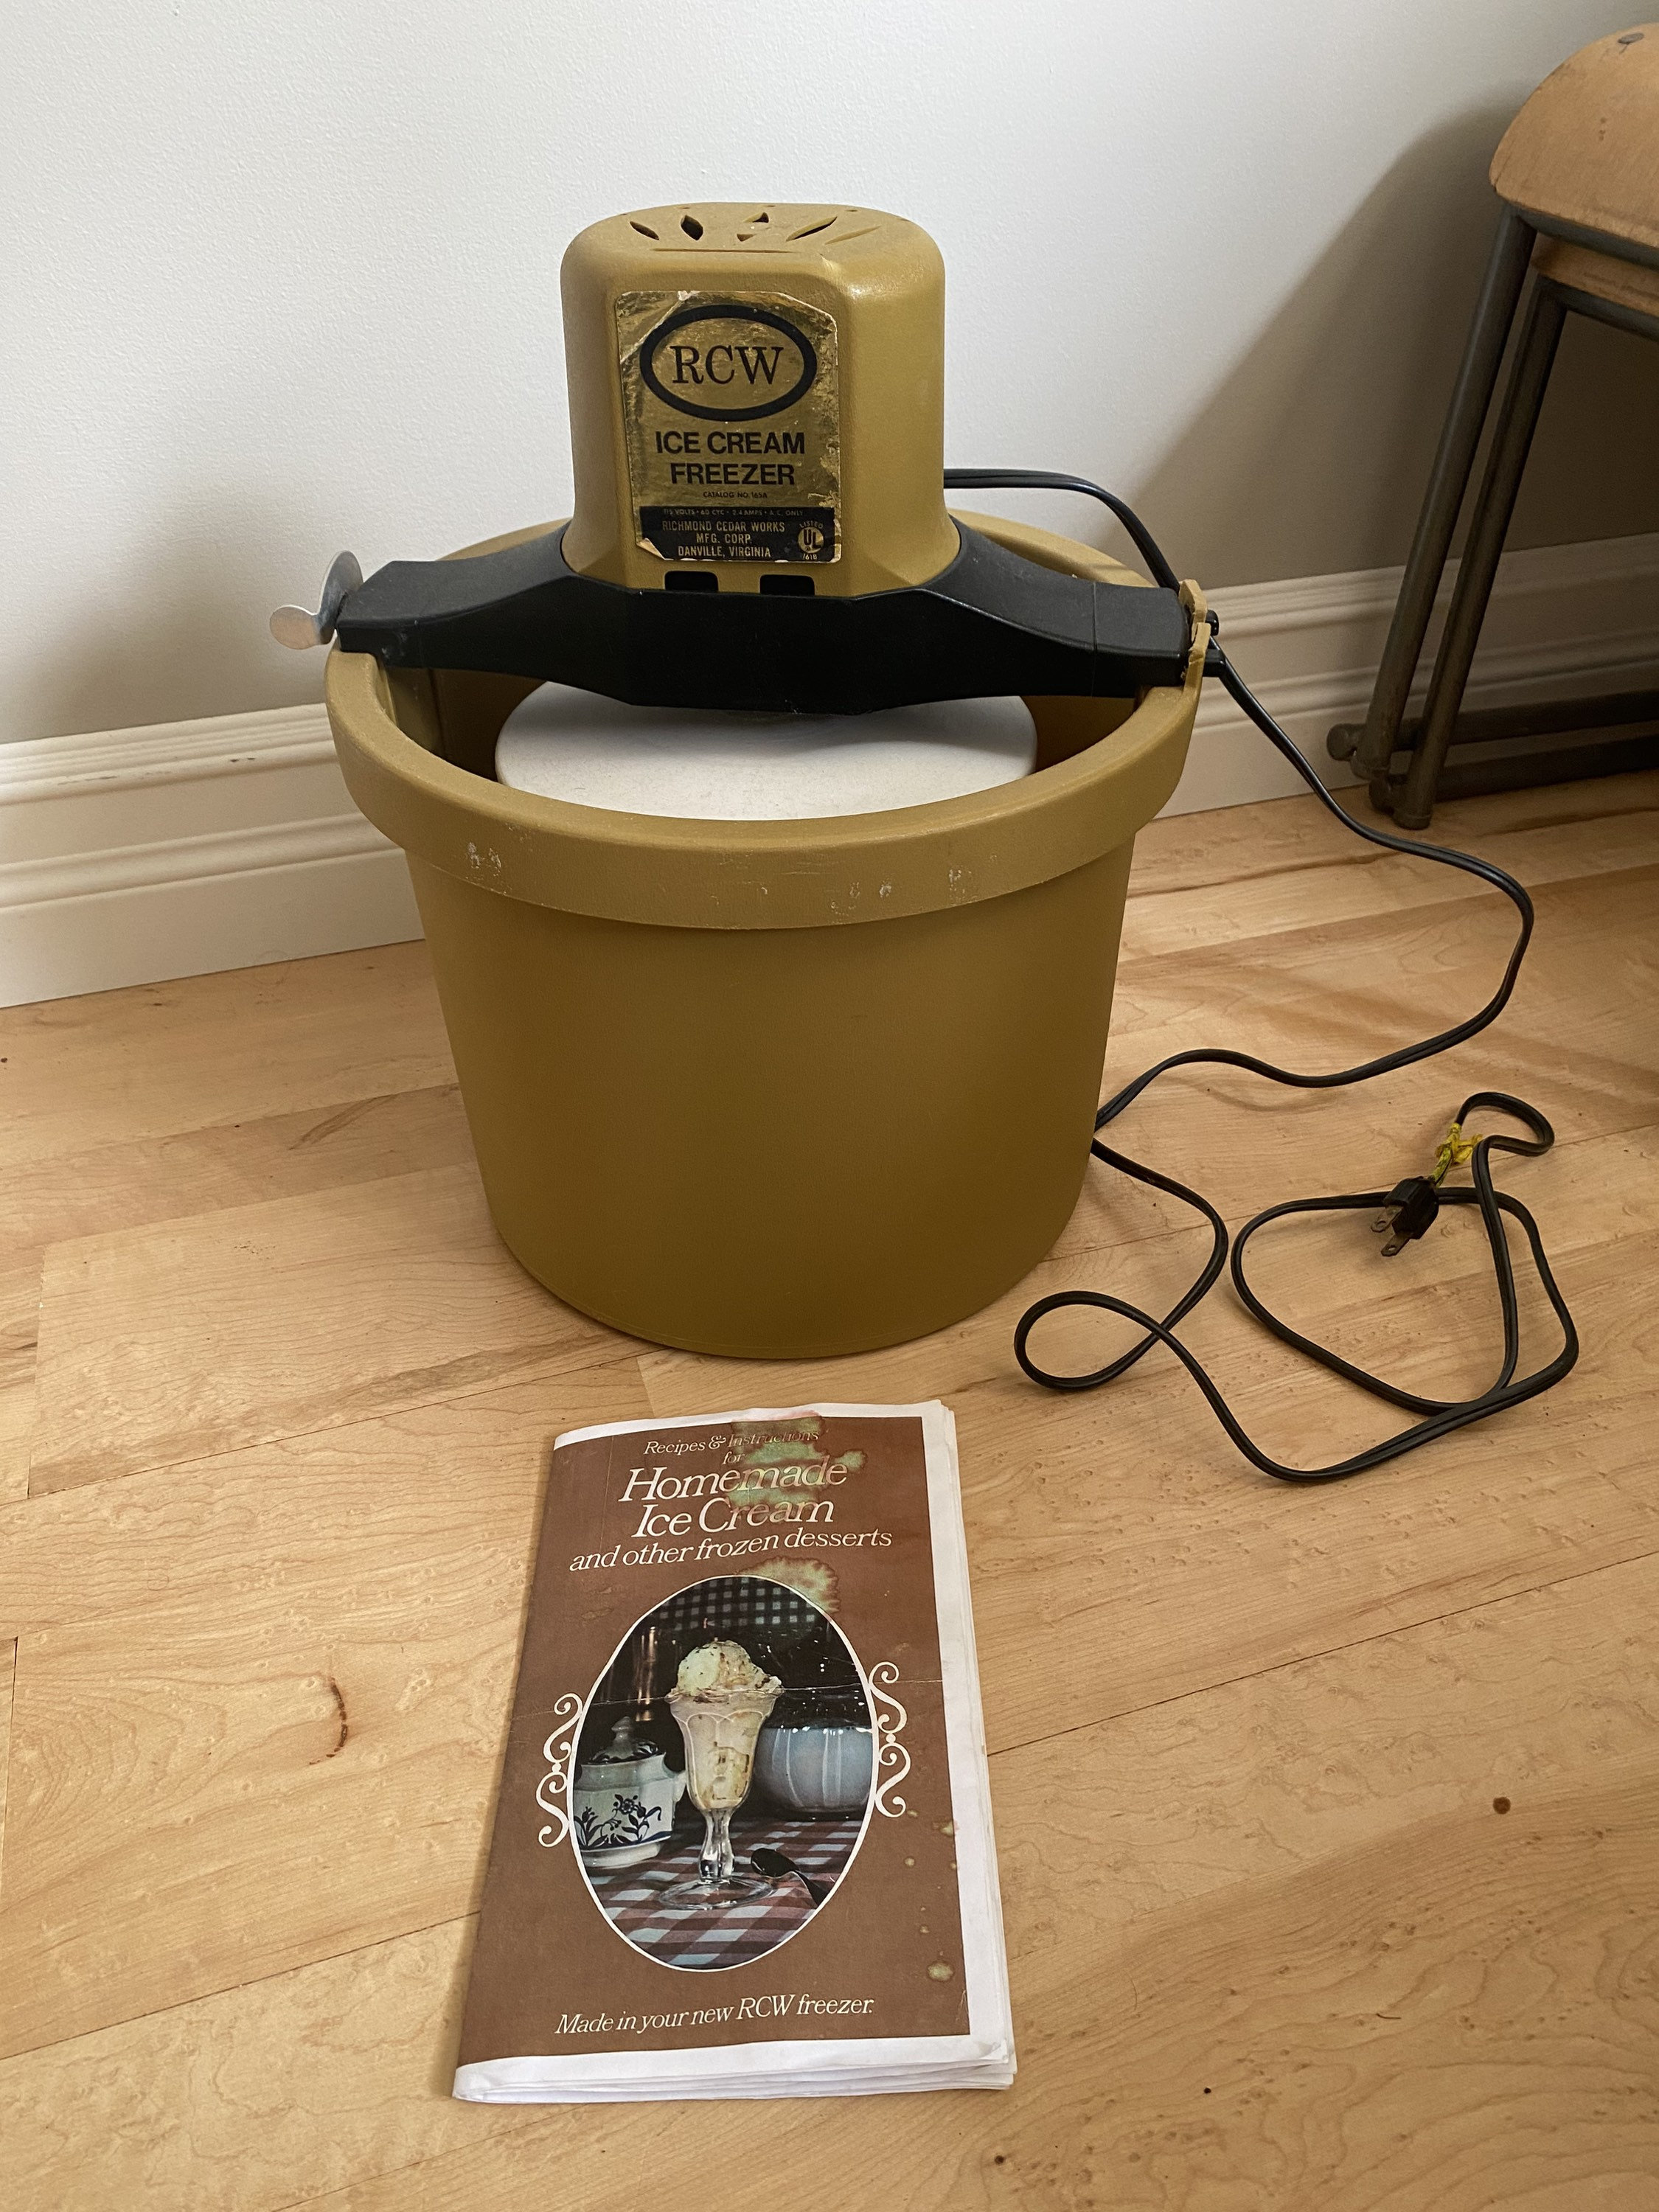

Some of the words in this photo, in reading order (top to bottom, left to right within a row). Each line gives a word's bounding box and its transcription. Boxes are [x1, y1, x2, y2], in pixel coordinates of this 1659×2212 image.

[669, 344, 784, 385] RCW
[655, 431, 700, 454] ICE
[707, 431, 805, 454] CREAM
[670, 462, 795, 485] FREEZER
[662, 521, 712, 532] RICHMOND
[716, 521, 746, 532] CEDAR
[751, 521, 785, 532] WORKS
[799, 520, 824, 529] LISTED
[696, 532, 720, 544] MFG.
[724, 533, 752, 544] CORP.
[804, 529, 821, 549] UL
[678, 546, 726, 557] DANVILLE,
[728, 546, 771, 558] VIRGINIA
[643, 1440, 706, 1455] Recipes
[708, 1435, 727, 1450] &
[727, 1430, 820, 1449] Instructions
[722, 1451, 745, 1465] for
[618, 1455, 848, 1503] Homemade
[631, 1503, 692, 1538] Ice
[698, 1497, 835, 1534] Cream
[568, 1545, 619, 1572] and
[622, 1539, 695, 1565] other
[693, 1531, 779, 1563] frozen
[783, 1528, 893, 1548] desserts
[554, 2014, 614, 2034] Made
[616, 2011, 636, 2031] in
[636, 2011, 690, 2034] your
[690, 2006, 735, 2025] new
[736, 1994, 796, 2020] RCW
[796, 1993, 874, 2016] freezer.
